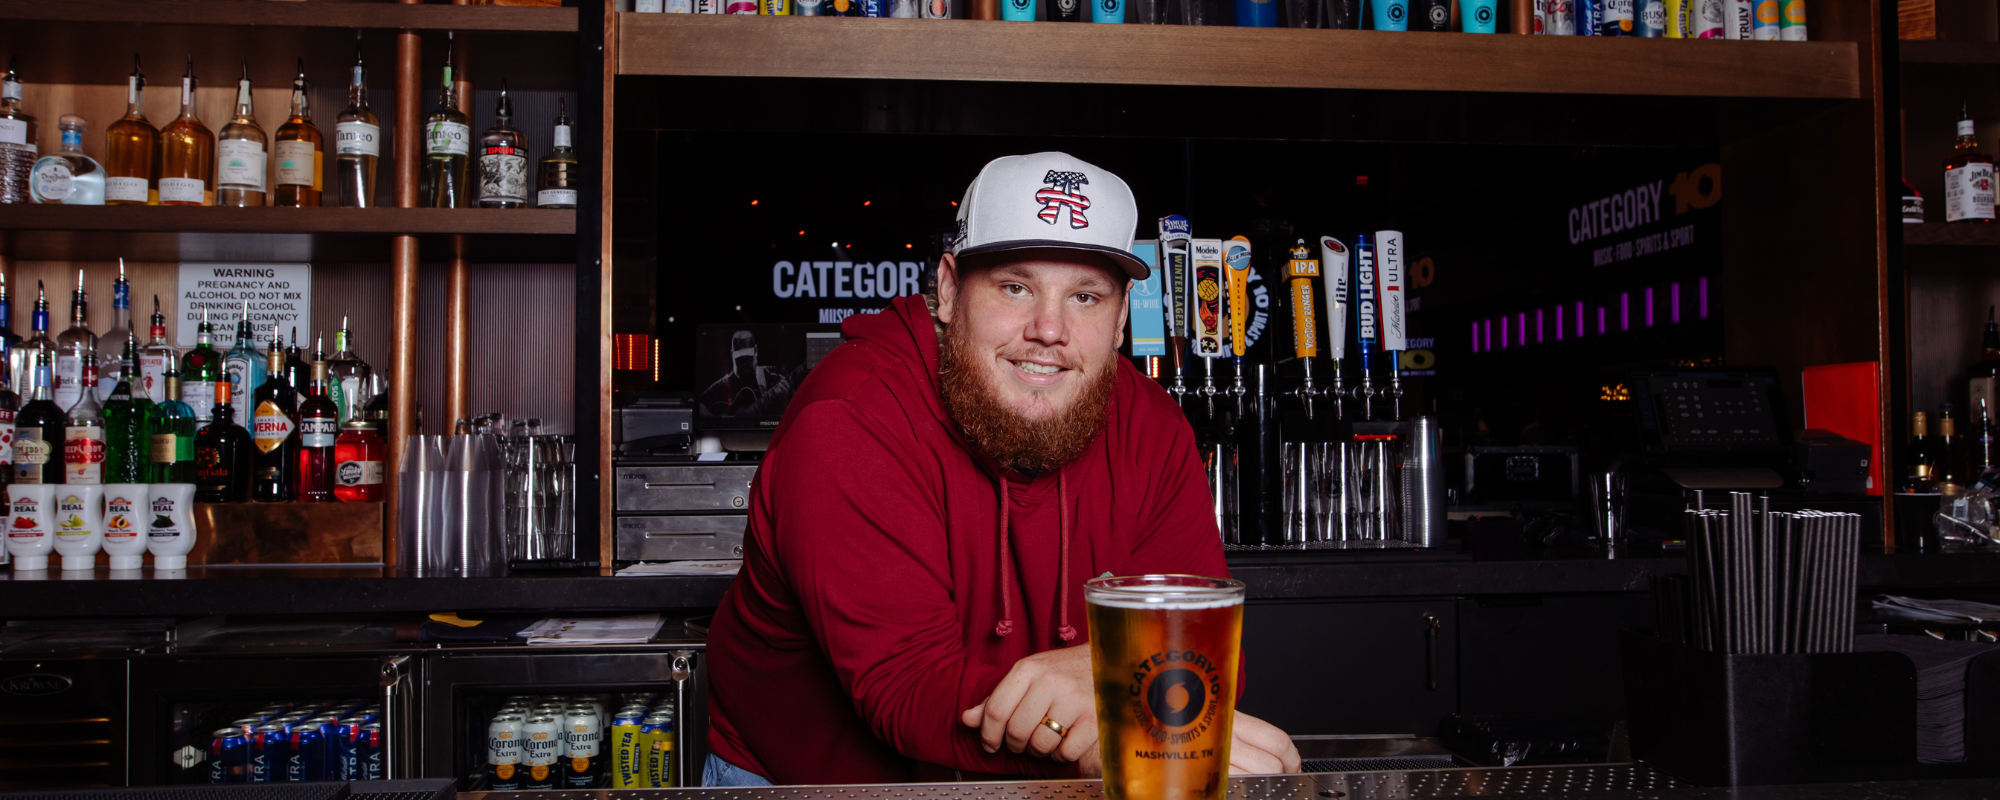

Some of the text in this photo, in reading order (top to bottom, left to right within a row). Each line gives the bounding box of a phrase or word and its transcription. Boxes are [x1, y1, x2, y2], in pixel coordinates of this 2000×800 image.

[1641, 11, 1664, 21] BUSC
[1739, 7, 1750, 40] TRULY
[1982, 168, 1994, 179] BEA
[1568, 162, 1722, 245] CATEGORY 10
[1165, 219, 1188, 227] SAMUEL
[1167, 224, 1188, 232] ADAMS
[1615, 240, 1633, 262] FOOD
[1636, 232, 1663, 257] SPIRITS
[1670, 224, 1695, 249] SPORT
[1196, 245, 1219, 254] Modelo
[1226, 252, 1240, 263] BLUE
[213, 268, 275, 278] WARNING
[1295, 261, 1317, 275] IPA
[198, 280, 290, 290] PREGNANCY AND
[1174, 255, 1184, 326] WINTER LAGER
[1387, 236, 1402, 340] Michelob ULTRA
[185, 291, 302, 300] ALCOHOL DO NOT MIX
[1335, 278, 1347, 305] lite
[1359, 248, 1375, 338] BUD LIGHT
[246, 302, 297, 311] ALCOHOL
[1301, 284, 1314, 349] VOODOO RANGER
[253, 323, 274, 331] USE
[1246, 311, 1269, 341] SPORT
[212, 334, 233, 342] RTH
[1406, 337, 1436, 350] EGORY
[255, 421, 288, 432] VERNA
[301, 422, 337, 433] CAMPARI
[623, 522, 647, 530] micros
[1130, 650, 1220, 698] CATEGORY 10
[1202, 700, 1218, 726] SPORT
[1199, 722, 1208, 733] &
[565, 731, 599, 745] Corona
[1146, 727, 1167, 743] FOOD
[1170, 727, 1201, 745] SPIRITS
[489, 737, 521, 752] Coron
[522, 738, 558, 753] Corona
[571, 742, 592, 750] Extra
[496, 749, 517, 757] Extra
[530, 750, 551, 758] Extra
[1135, 749, 1214, 760] NASHVILLE, TN
[621, 732, 633, 787] TWISTED TEA
[650, 757, 662, 787] WISTED
